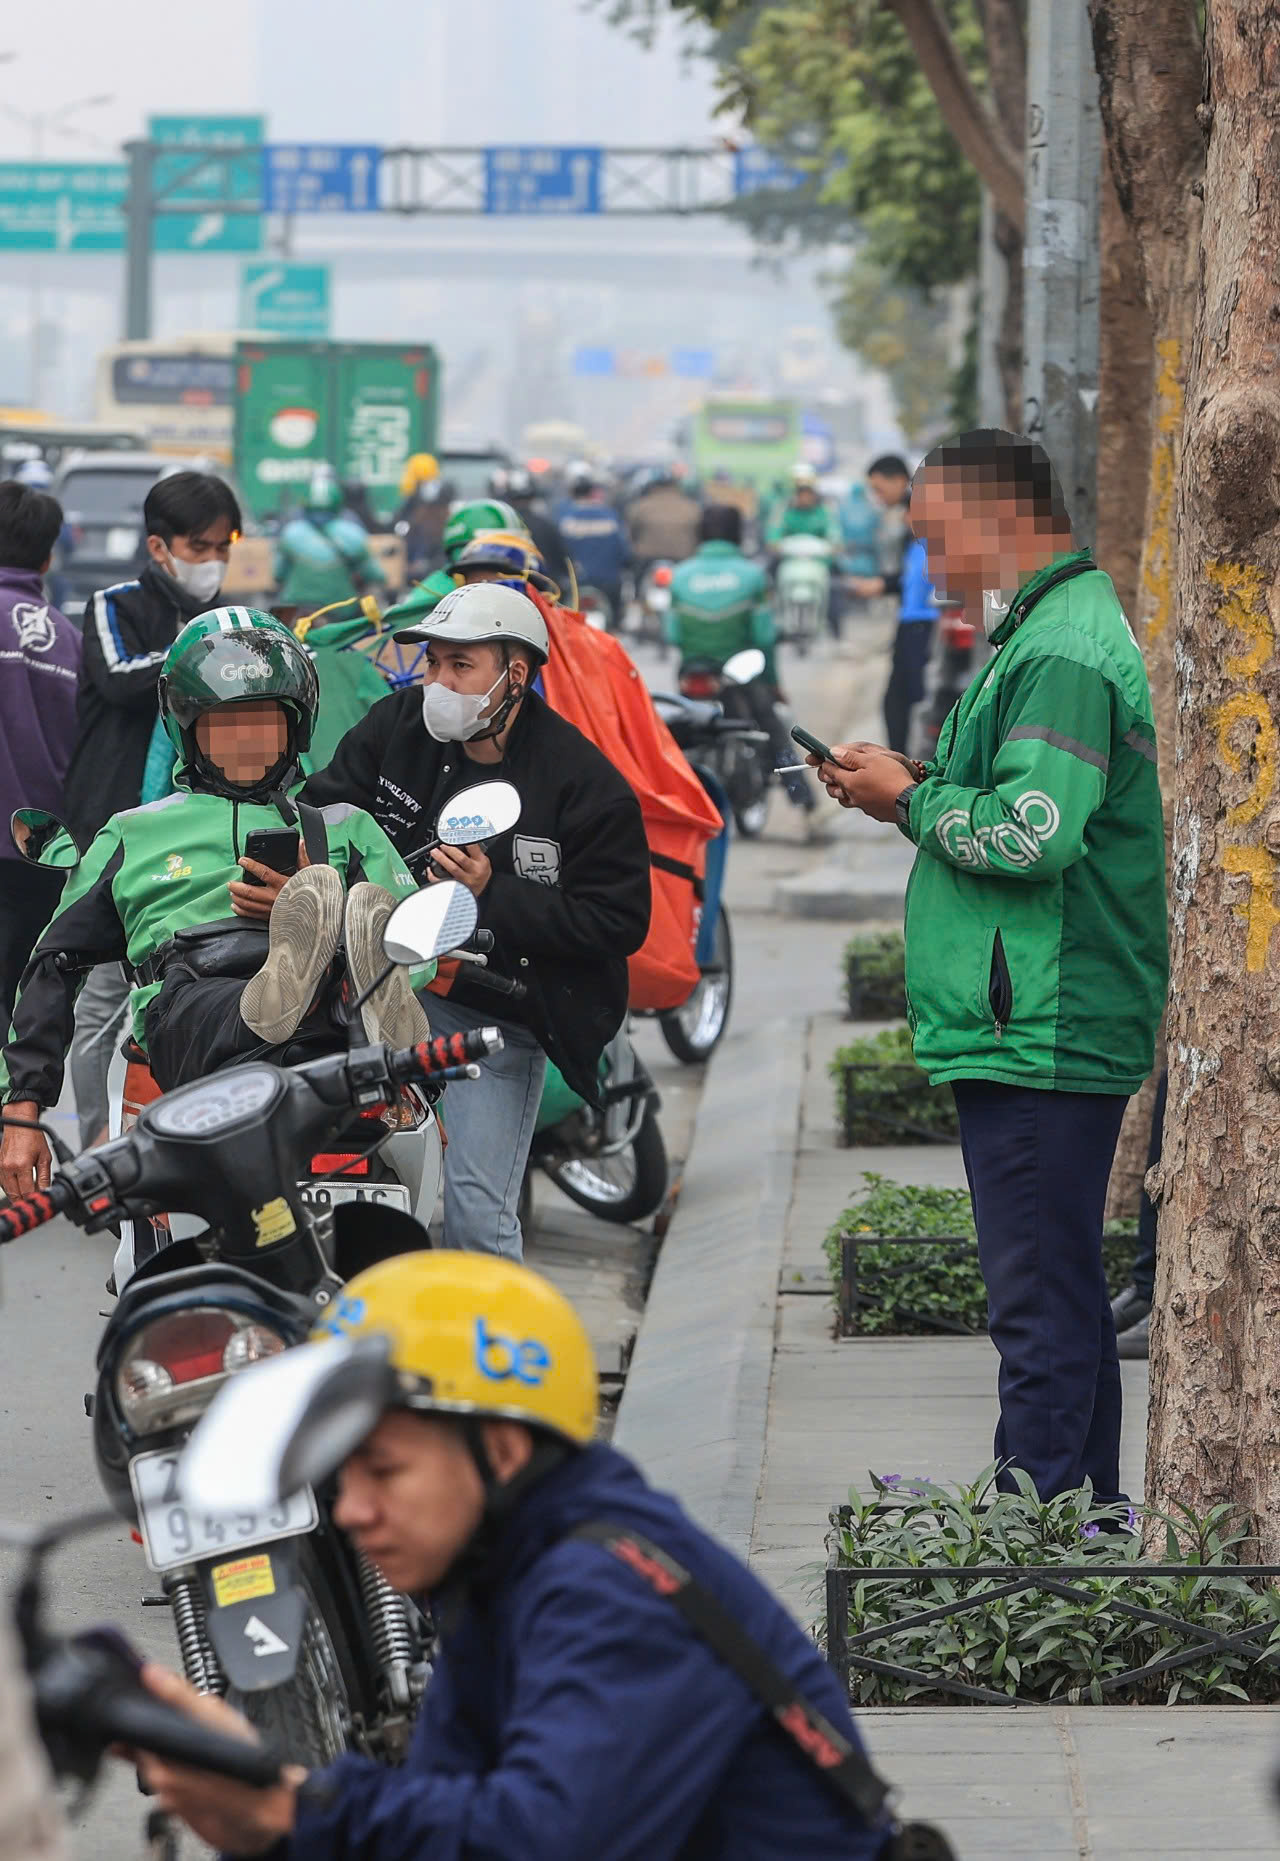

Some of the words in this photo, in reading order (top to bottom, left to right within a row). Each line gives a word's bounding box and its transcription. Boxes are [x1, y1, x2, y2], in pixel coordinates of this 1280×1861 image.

[220, 663, 273, 682] Grab
[935, 790, 1060, 869] Grab
[474, 1316, 552, 1387] be
